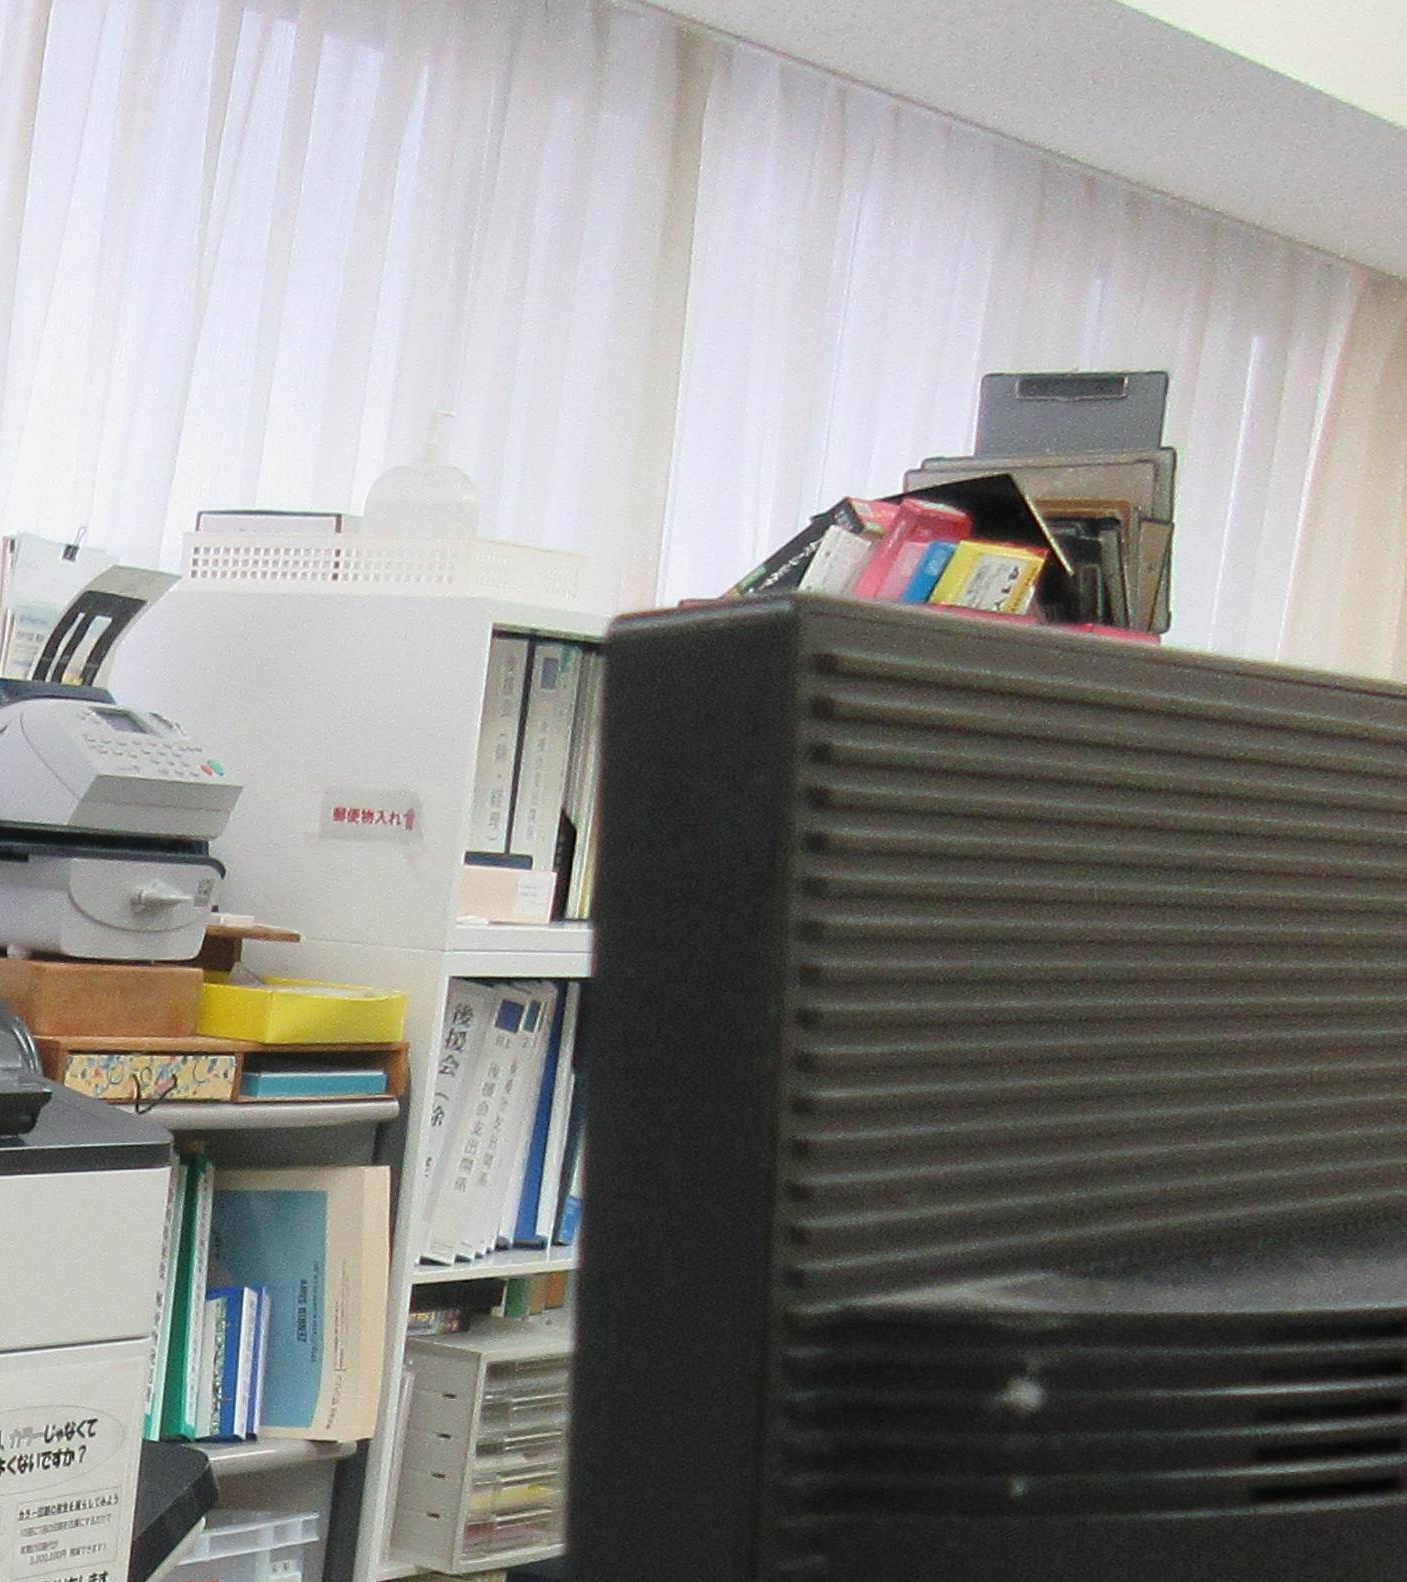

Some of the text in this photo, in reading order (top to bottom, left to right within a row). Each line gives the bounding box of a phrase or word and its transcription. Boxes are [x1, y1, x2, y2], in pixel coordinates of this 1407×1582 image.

[332, 806, 401, 826] 郵便物入れ
